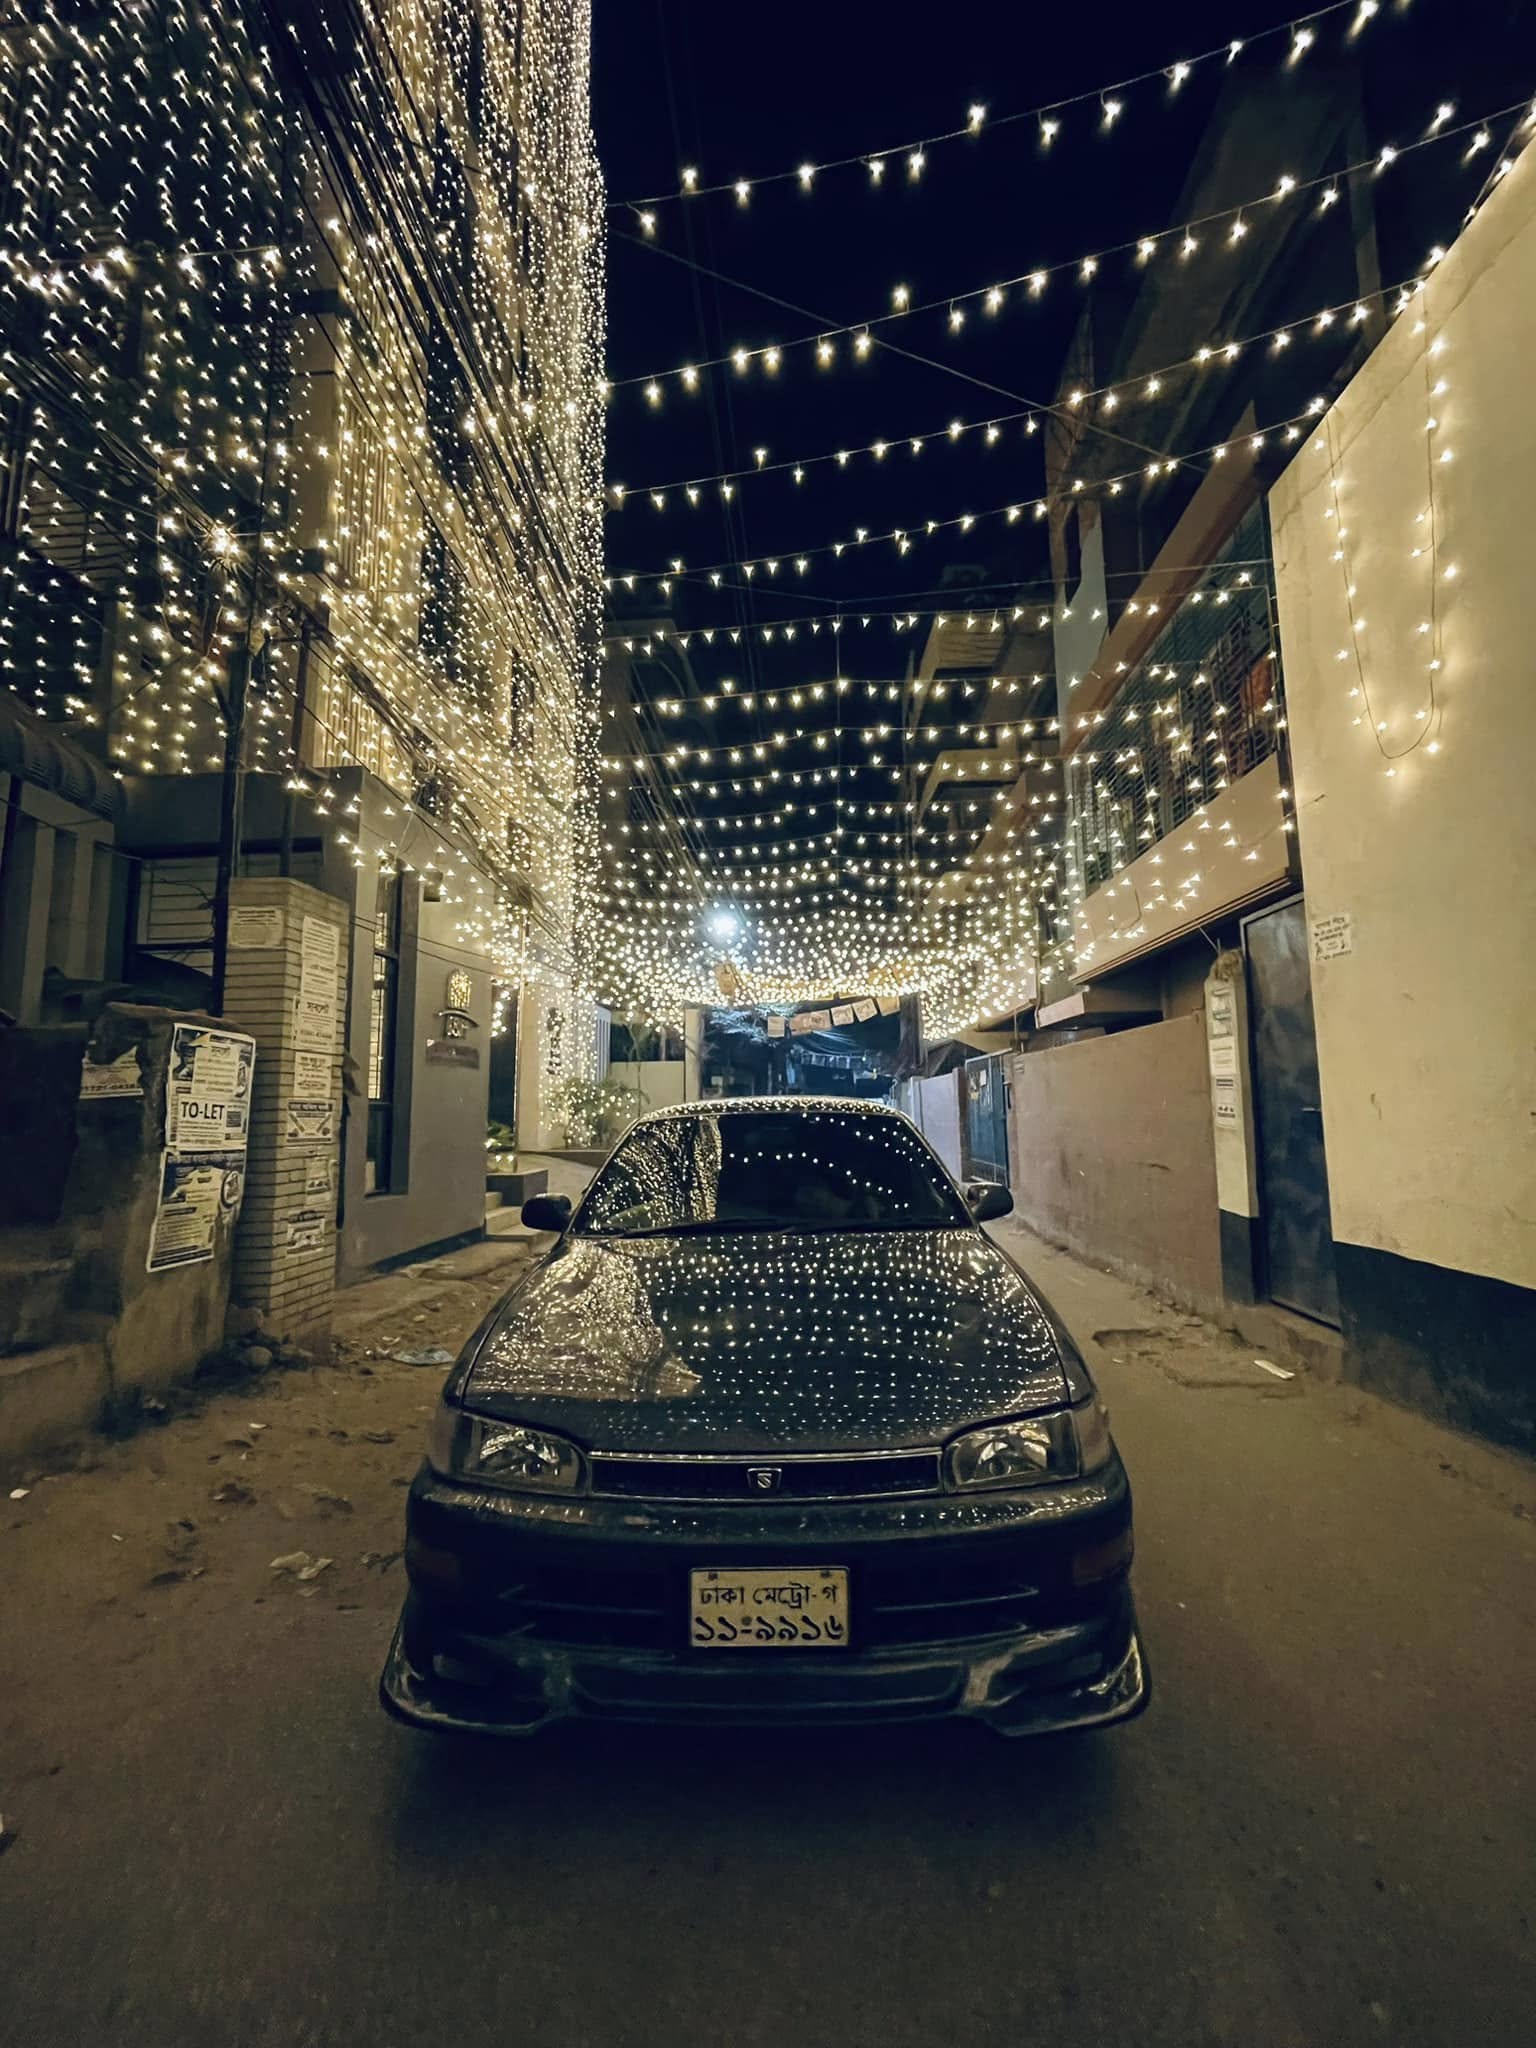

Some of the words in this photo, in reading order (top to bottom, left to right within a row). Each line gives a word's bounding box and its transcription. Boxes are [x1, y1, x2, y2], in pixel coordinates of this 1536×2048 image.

[181, 1101, 225, 1120] TO-LET
[699, 1586, 745, 1604] ঢাকা
[694, 1615, 844, 1641] ১১-৯৯১৬
